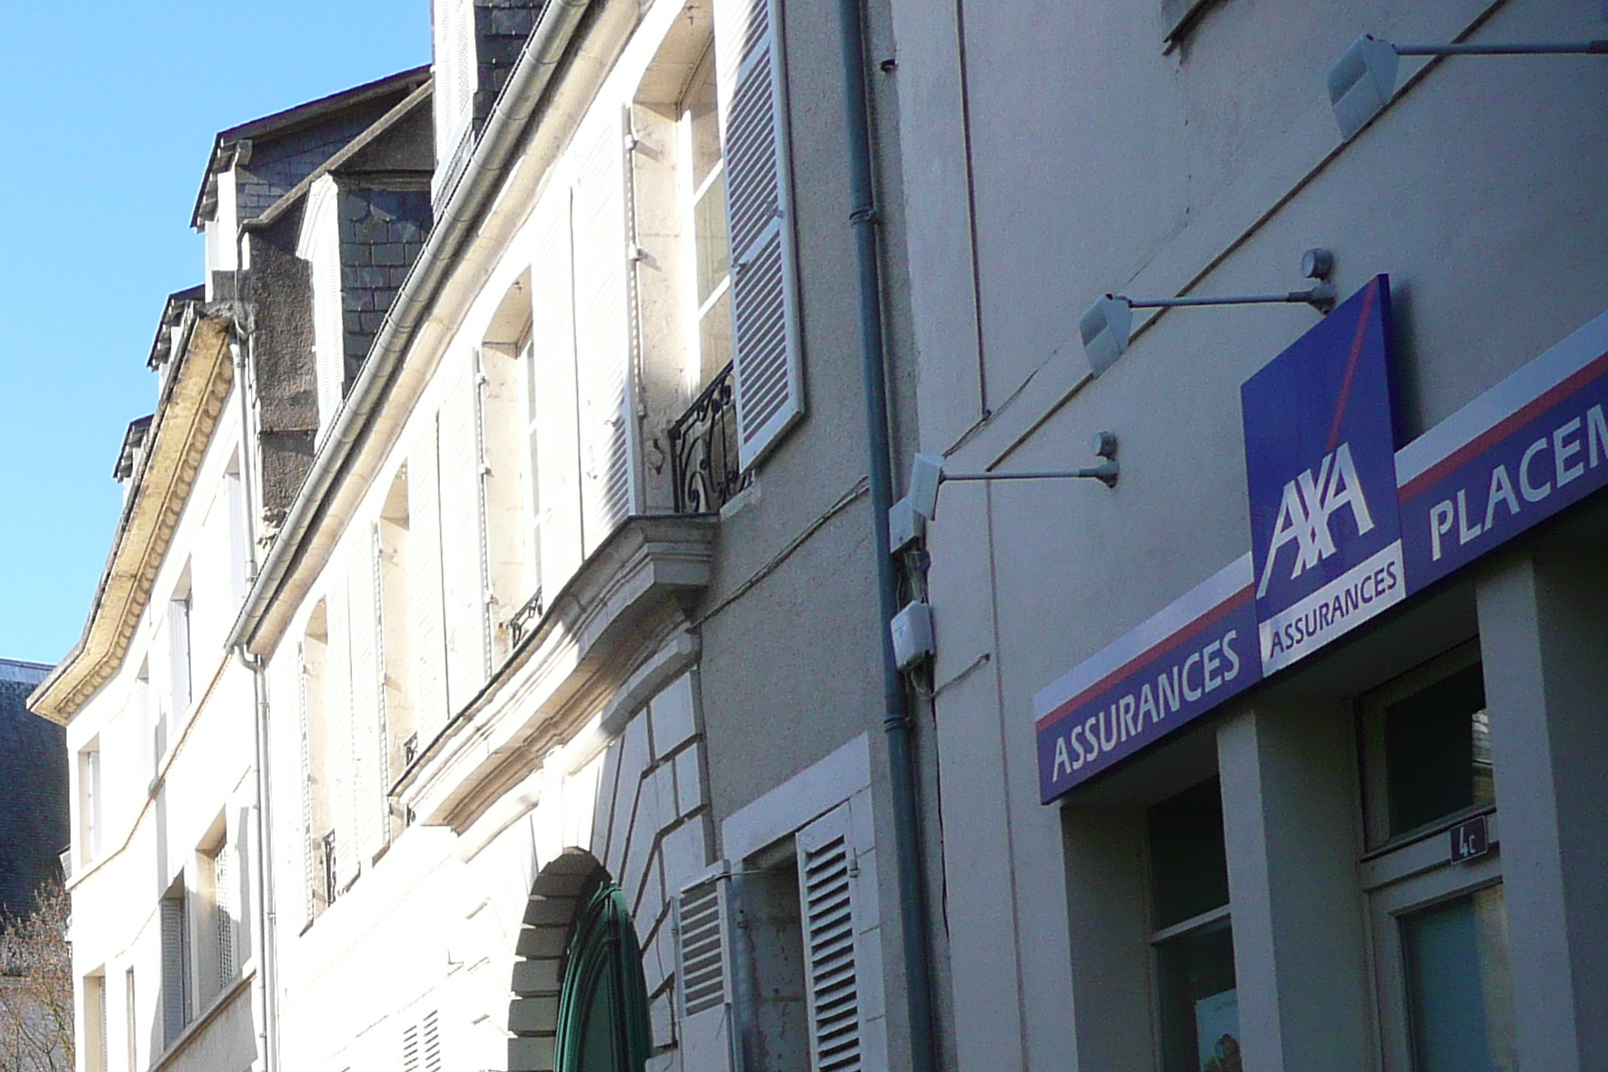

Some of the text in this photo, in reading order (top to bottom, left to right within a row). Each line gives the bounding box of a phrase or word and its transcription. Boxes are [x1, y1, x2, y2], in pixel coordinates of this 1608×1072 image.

[1256, 441, 1376, 600] AXA
[1269, 561, 1398, 659] ASSURANCES
[1052, 629, 1240, 783] ASSURANCES
